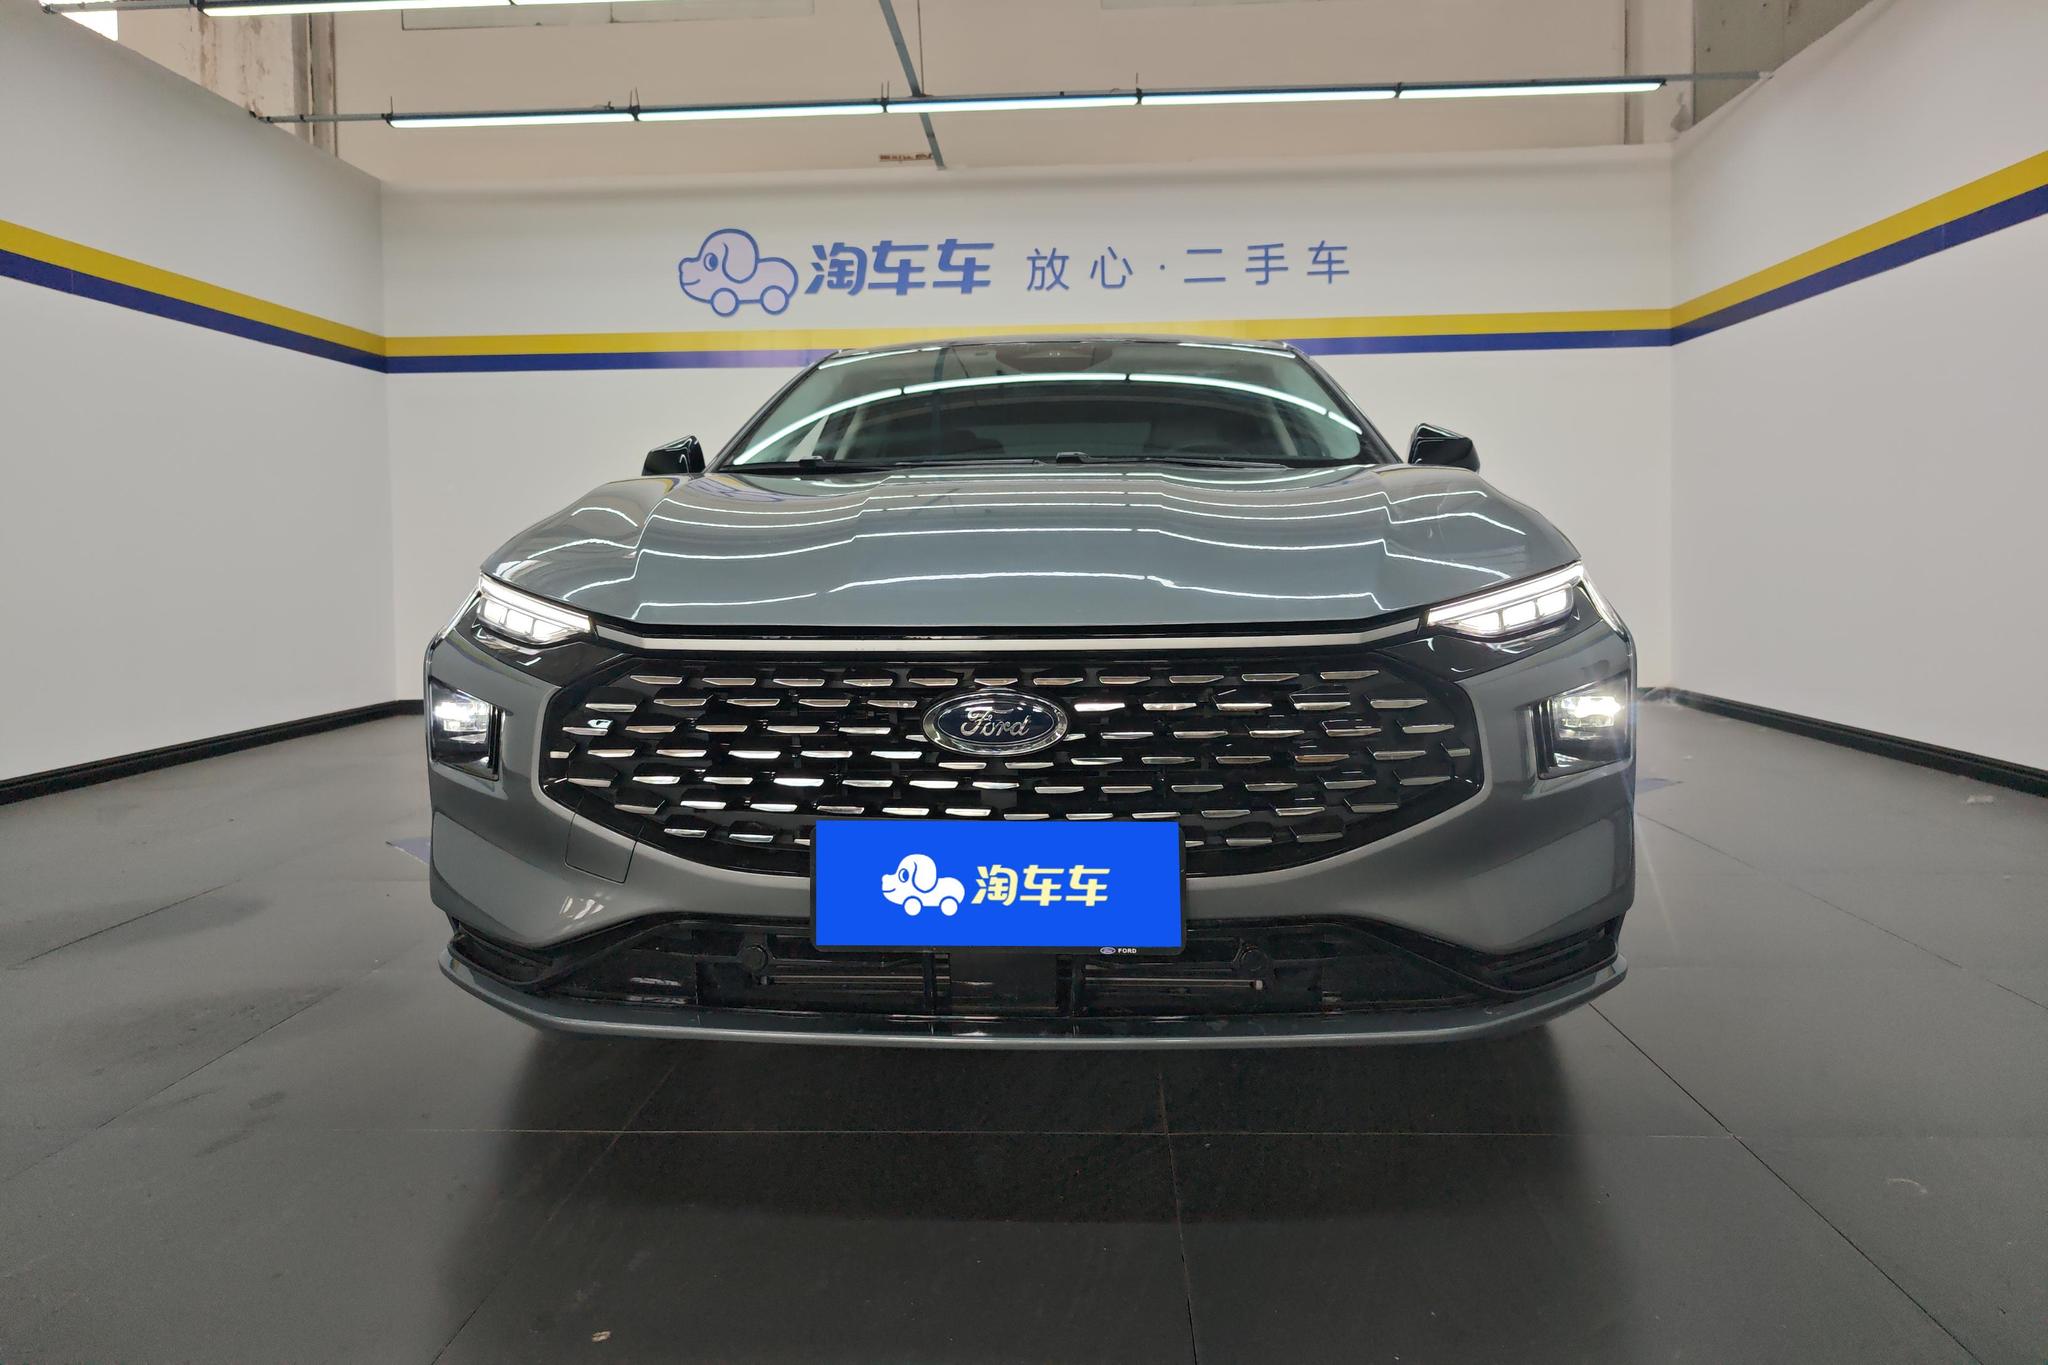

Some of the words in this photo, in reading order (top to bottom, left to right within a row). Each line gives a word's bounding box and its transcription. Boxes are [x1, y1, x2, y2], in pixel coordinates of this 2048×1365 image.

[805, 239, 994, 295] 淘车车
[960, 706, 1031, 737] Ford
